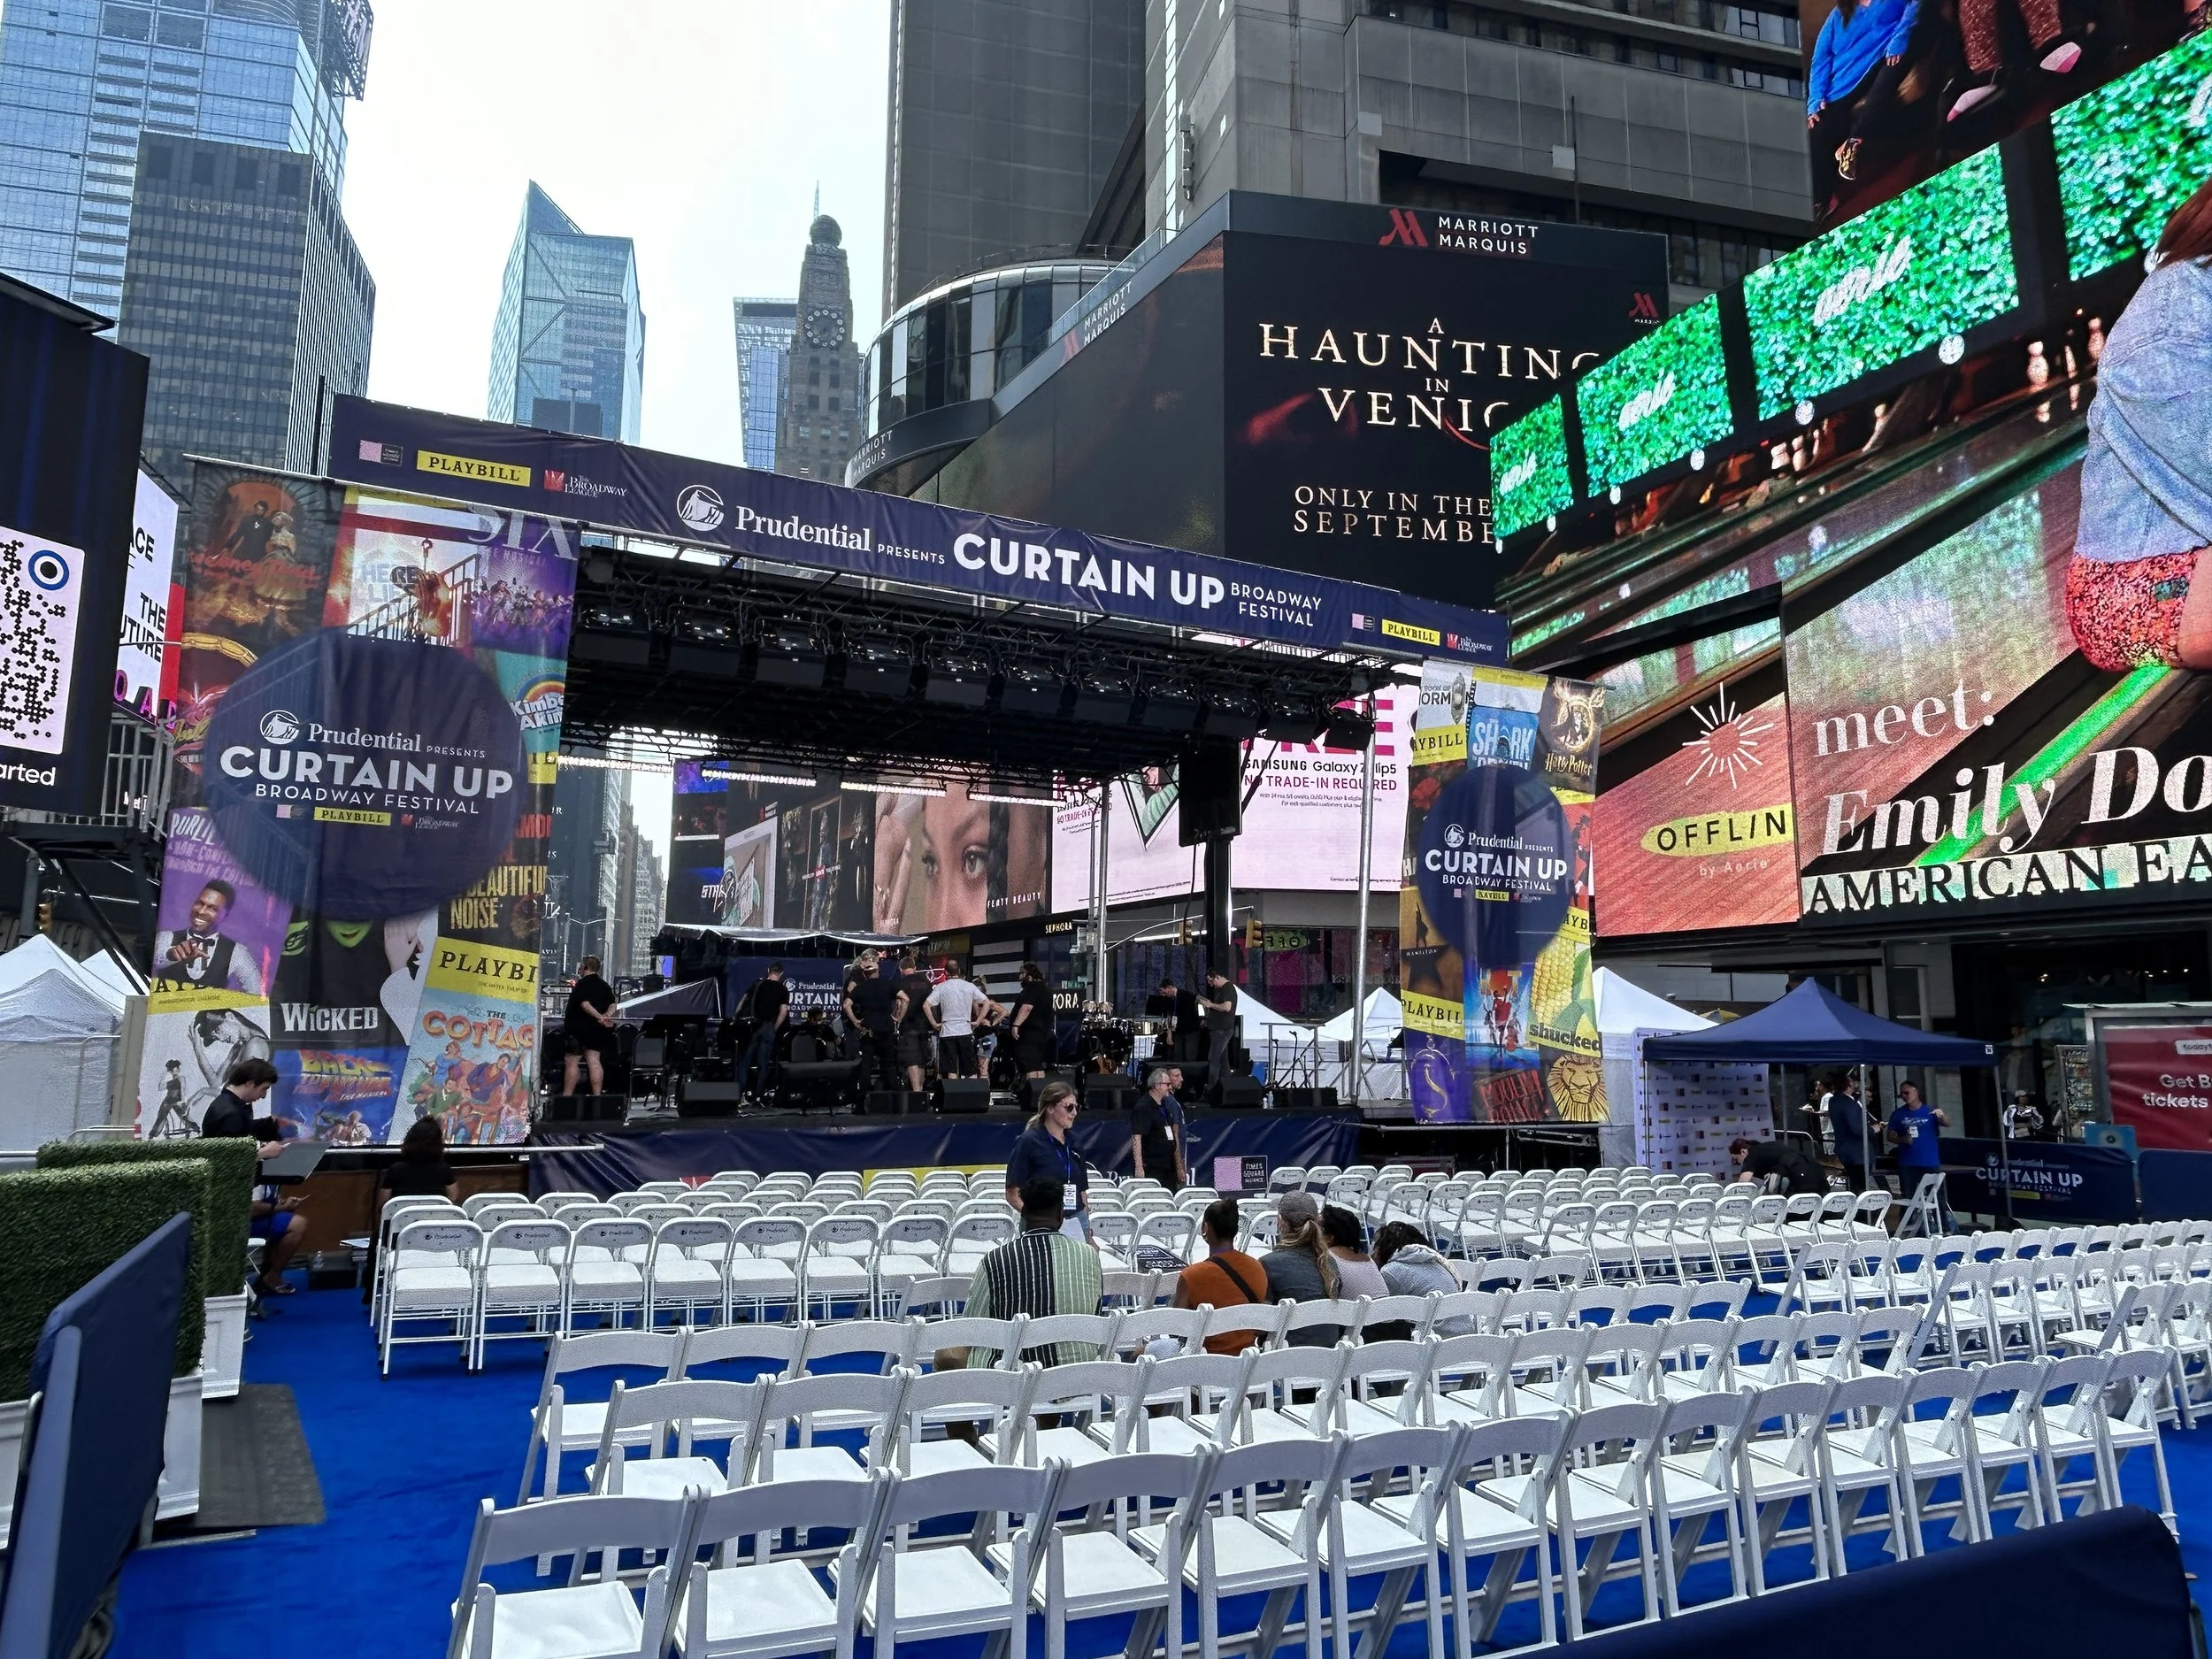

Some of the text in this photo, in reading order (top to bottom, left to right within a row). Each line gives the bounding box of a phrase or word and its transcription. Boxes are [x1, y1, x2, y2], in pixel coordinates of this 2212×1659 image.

[1438, 216, 1539, 238] MARRIOTT
[1439, 234, 1528, 255] MARQUIS
[1084, 280, 1132, 331] MARRIOTT
[1084, 303, 1125, 347] MARQUIS
[1427, 317, 1445, 334] A
[1425, 377, 1450, 393] IN
[428, 456, 520, 481] PLAYBILL
[570, 476, 627, 496] BROADWAY
[1294, 485, 1493, 518] ONLY IN THE
[467, 503, 577, 559] SIX
[734, 505, 1225, 610] Prudential PRESENTS CURTAIN UP
[1230, 582, 1323, 611] BROADWAY
[140, 591, 167, 633] THE
[1239, 602, 1315, 627] FESTIVAL
[1387, 623, 1435, 642] PLAYBILL
[1811, 677, 1995, 758] meet:
[307, 722, 486, 759] Prudential PRESENTS
[219, 745, 513, 799] CURTAIN UP
[1245, 758, 1308, 772] SAMSUNG
[1312, 761, 1358, 776] Galaxy
[1544, 751, 1568, 774] Harry
[1567, 755, 1594, 777] Potter
[1266, 775, 1329, 789] TRADE-IN
[1333, 777, 1397, 791] REQURED
[255, 783, 479, 815] BROADWAY FESTIVAL
[1821, 746, 2212, 856] Emily Do
[321, 810, 385, 824] PLAYBILL
[1468, 832, 1524, 850] Prudential
[1425, 849, 1568, 880] CURTAIN UP
[1699, 858, 1768, 879] by Aerie
[1442, 874, 1552, 892] BROADWAY FESTIVAL
[1809, 845, 2108, 914] AMERICAN
[1013, 891, 1042, 904] BEAUTY
[450, 897, 499, 930] NOISE
[1045, 921, 1073, 933] SEPHORA
[439, 950, 539, 984] PLAYBI
[798, 981, 836, 991] Prudential
[486, 1010, 507, 1020] THE
[2159, 1073, 2196, 1089] Get
[2141, 1091, 2208, 1109] tickets
[2058, 1172, 2084, 1188] UP
